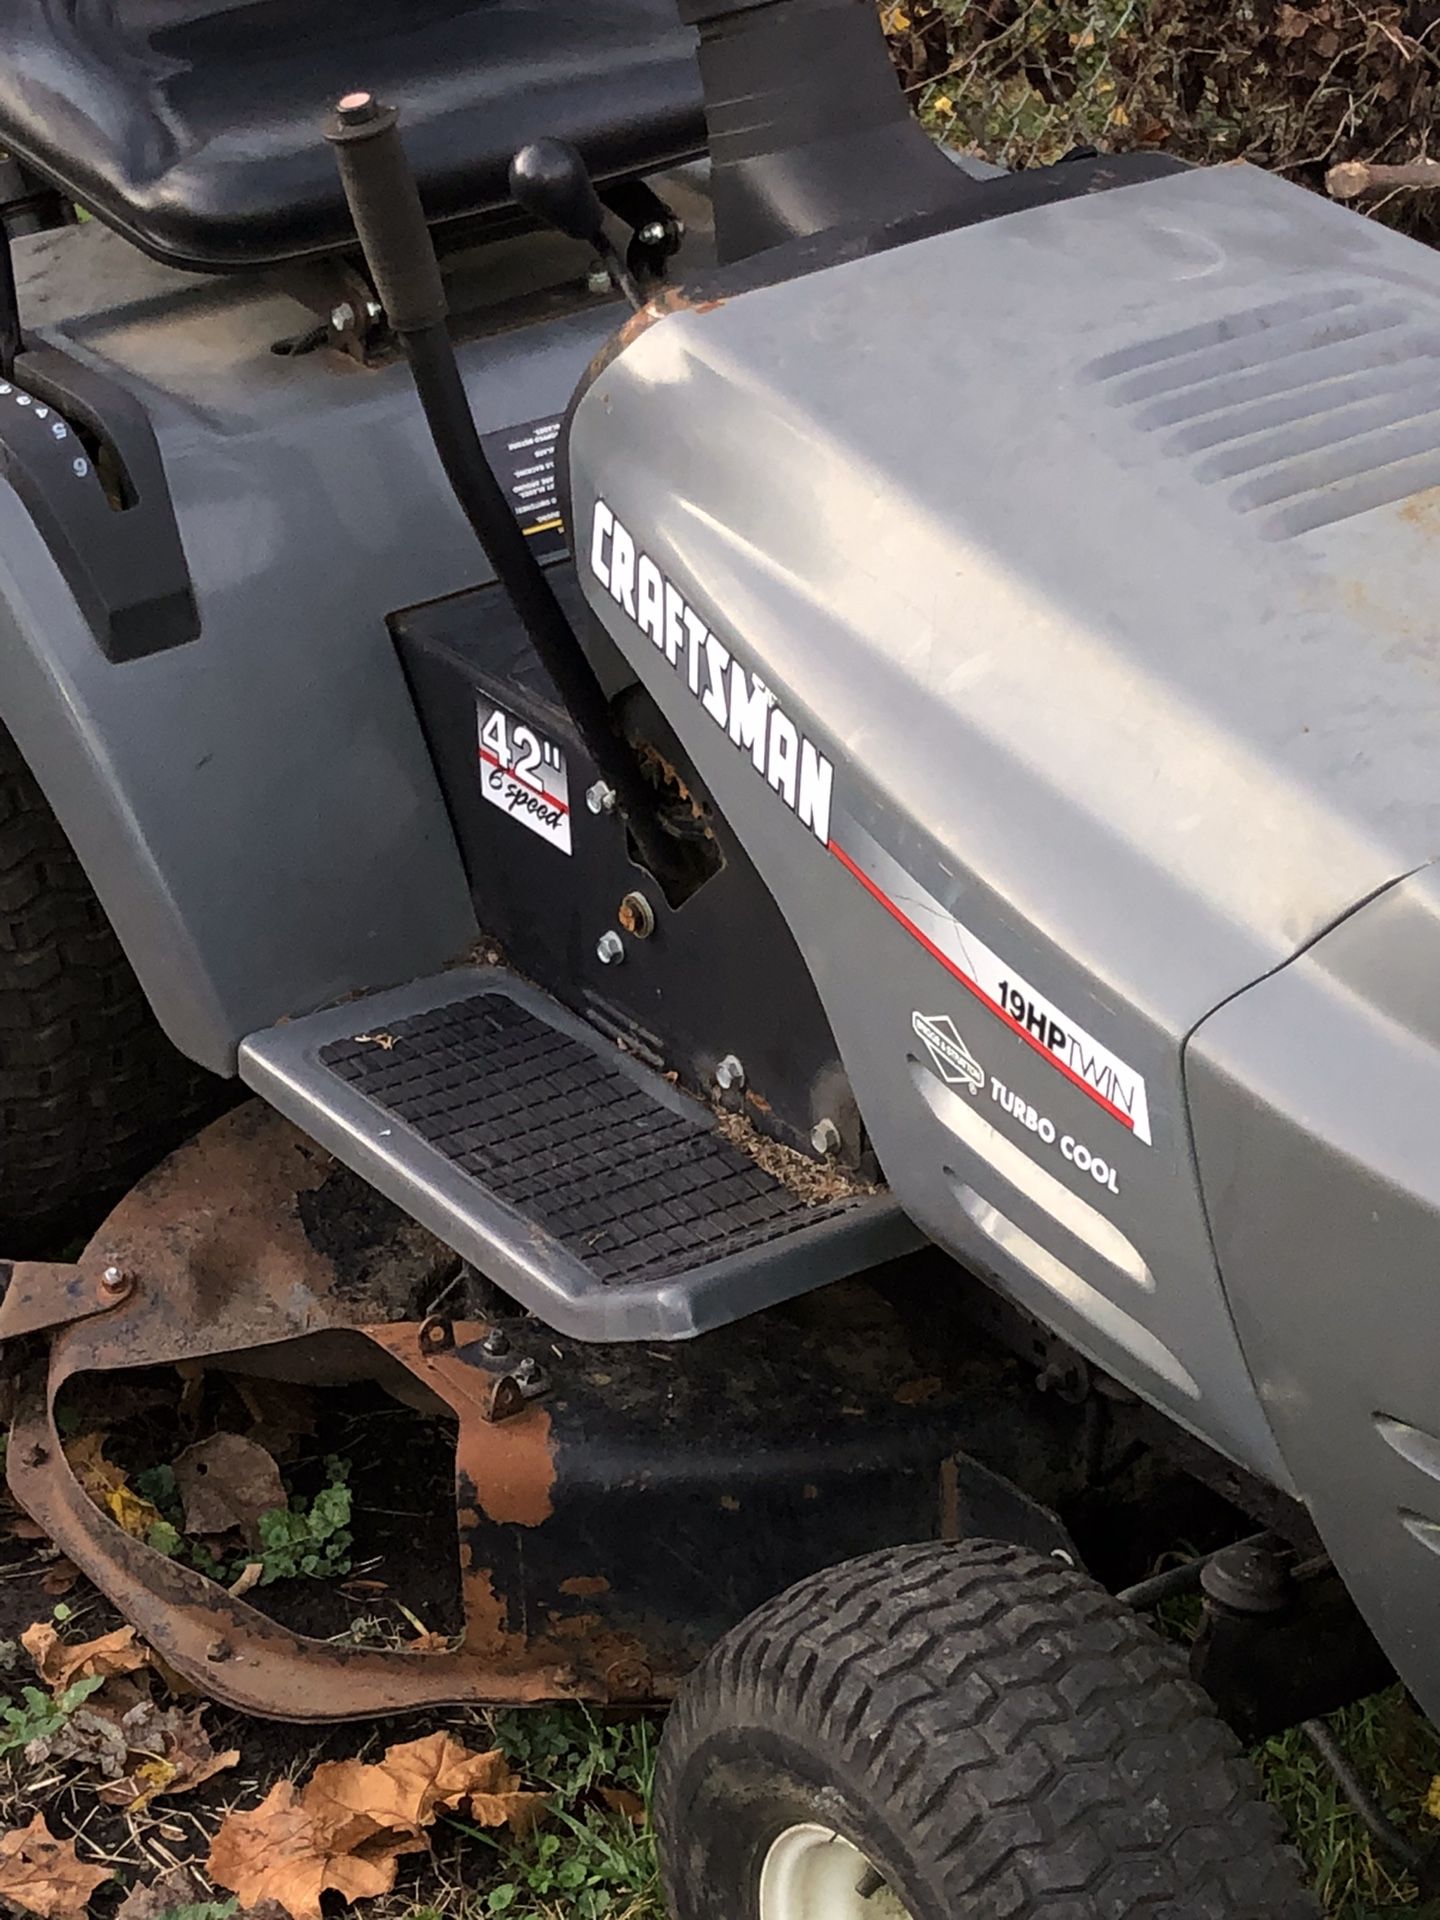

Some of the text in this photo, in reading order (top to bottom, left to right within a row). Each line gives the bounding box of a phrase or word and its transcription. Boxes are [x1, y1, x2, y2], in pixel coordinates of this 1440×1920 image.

[52, 422, 67, 440] 5
[590, 499, 835, 850] CRAFTSMAN
[481, 709, 562, 793] 42"
[488, 768, 563, 831] 6 speed
[989, 1076, 1120, 1195] TURBO COOL
